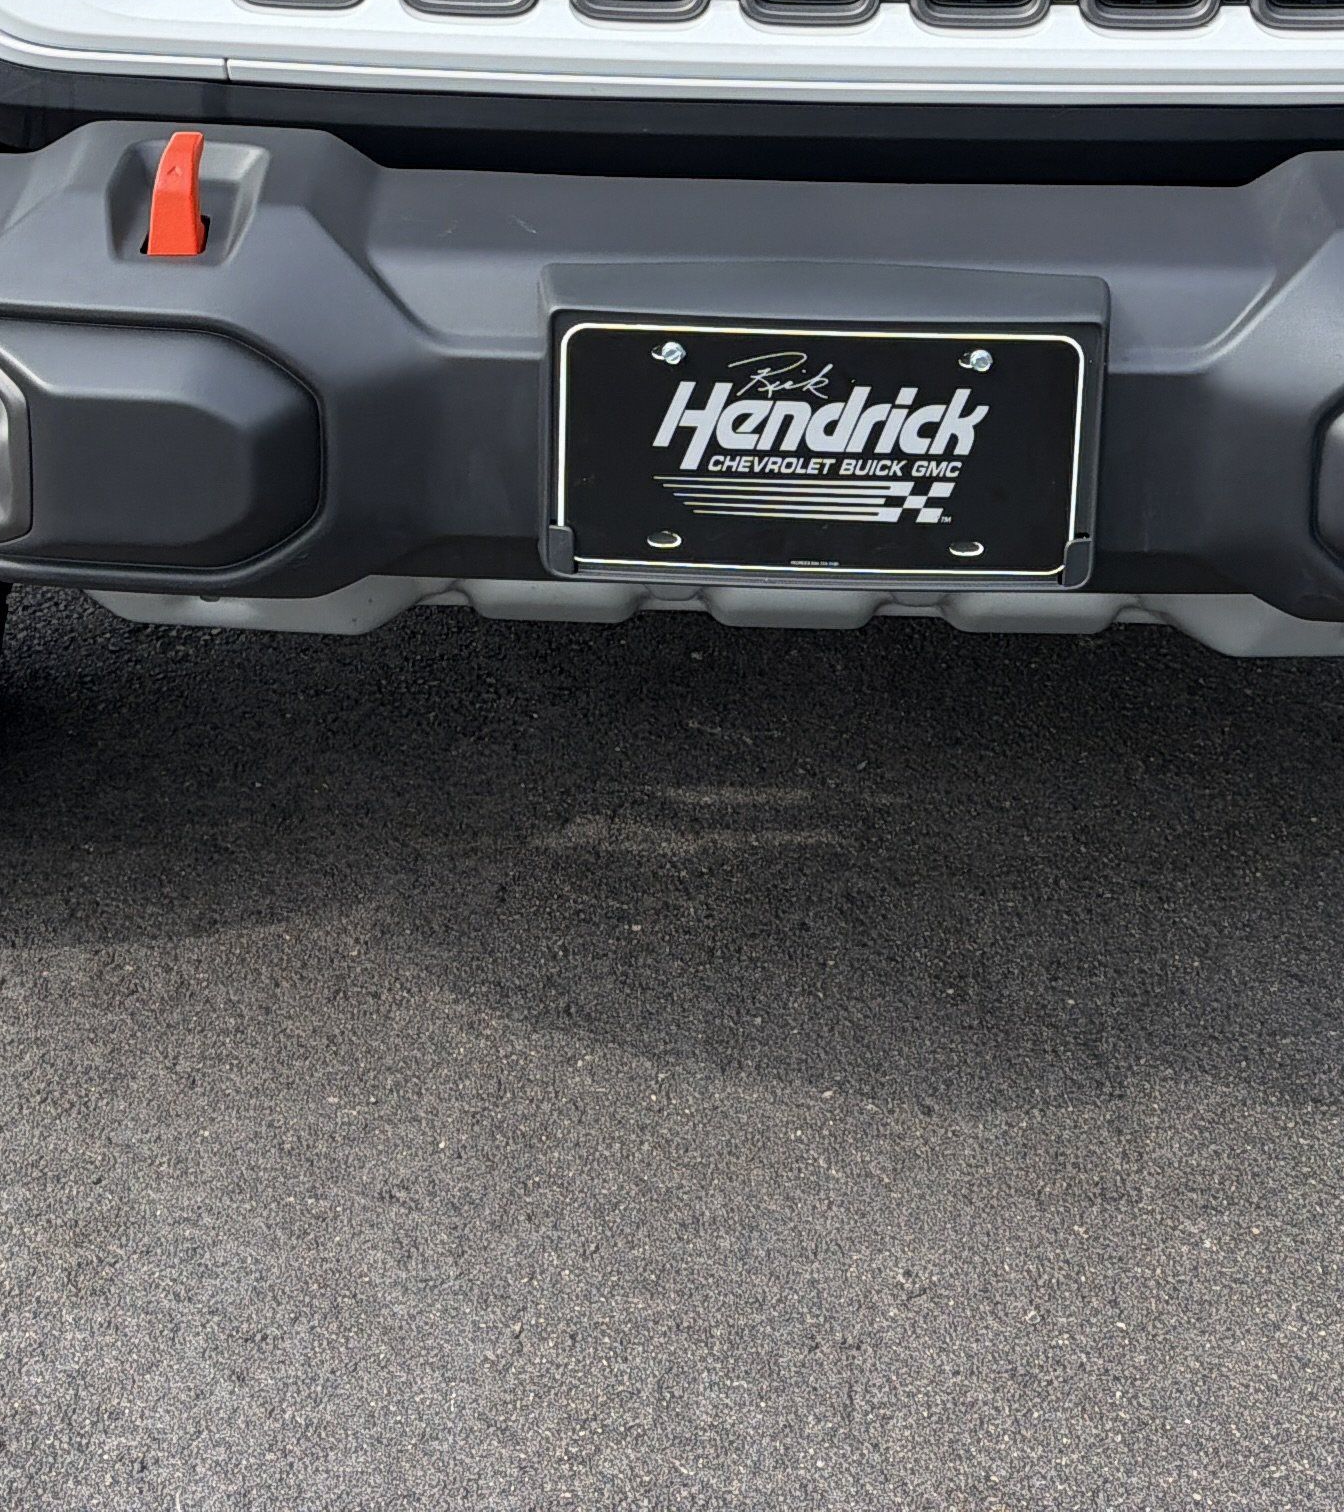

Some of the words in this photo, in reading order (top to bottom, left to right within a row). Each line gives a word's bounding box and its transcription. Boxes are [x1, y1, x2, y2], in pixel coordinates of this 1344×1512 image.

[652, 381, 990, 470] Hendrick
[707, 455, 836, 475] CHEVROLET
[839, 458, 908, 476] BUICK
[911, 461, 962, 478] GMC
